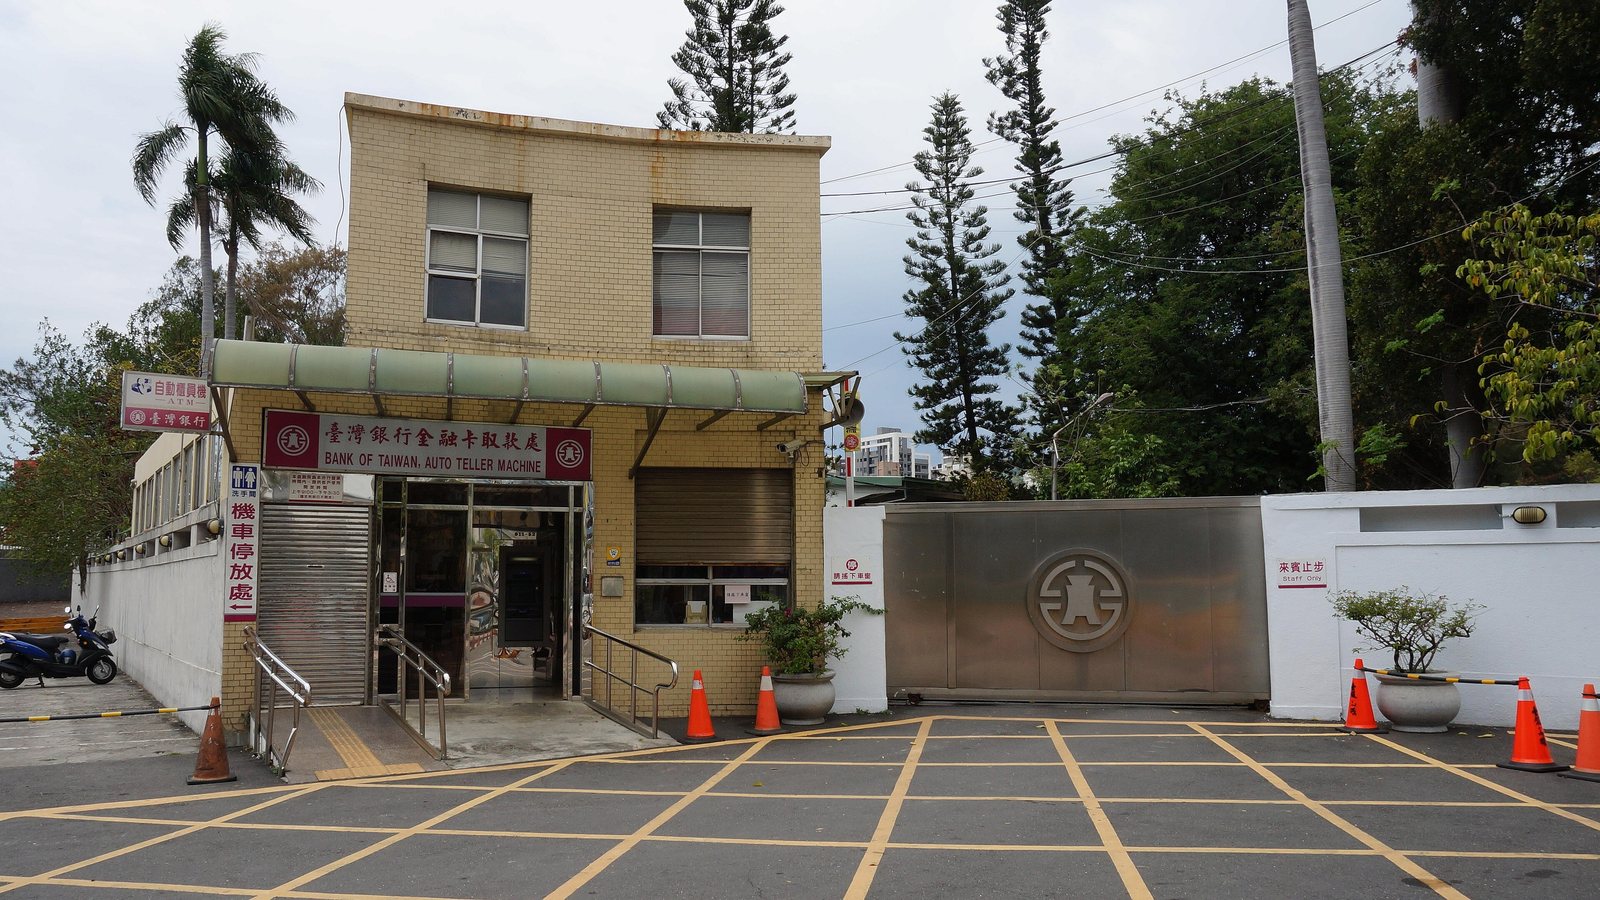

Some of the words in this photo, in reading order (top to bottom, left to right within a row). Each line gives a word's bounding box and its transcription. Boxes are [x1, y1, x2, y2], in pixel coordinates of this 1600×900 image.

[155, 380, 207, 399] 自動櫃員機
[168, 398, 194, 406] ATM
[149, 411, 206, 428] 臺灣銀行
[325, 422, 542, 453] 臺灣銀行金融卡取款處
[325, 452, 354, 466] BANK
[359, 453, 373, 467] OF
[378, 454, 421, 469] TAIWAN,
[425, 456, 452, 470] AUTO
[456, 457, 494, 472] TELLER
[497, 460, 541, 473] MACHINE
[231, 490, 257, 498] 洗手間
[229, 502, 256, 601] 機車停放處
[1279, 561, 1324, 573] 來賓止步
